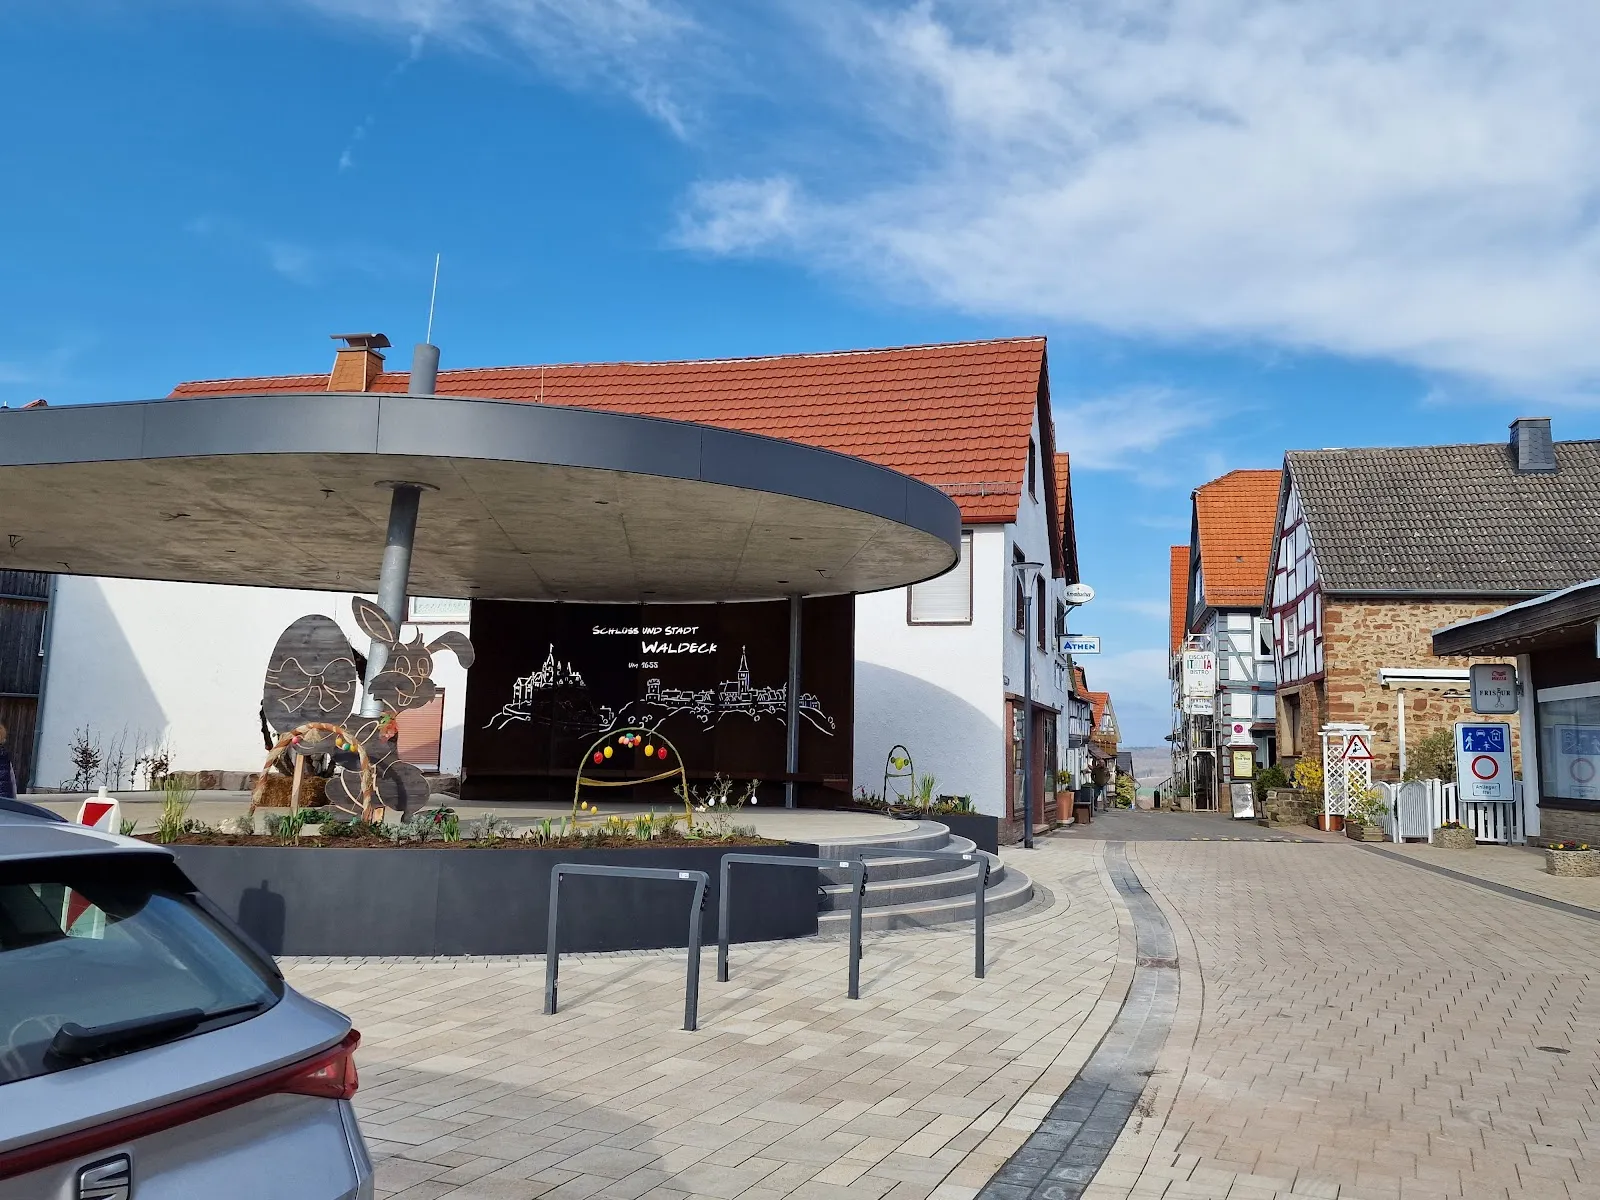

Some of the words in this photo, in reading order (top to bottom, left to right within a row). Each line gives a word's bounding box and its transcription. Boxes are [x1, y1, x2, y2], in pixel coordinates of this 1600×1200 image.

[592, 625, 640, 635] SCHLOSS
[642, 627, 662, 635] UND
[664, 625, 699, 636] STADT
[641, 641, 717, 654] WALDECK
[1063, 641, 1096, 650] ATHEN
[1187, 660, 1212, 669] ITALIA
